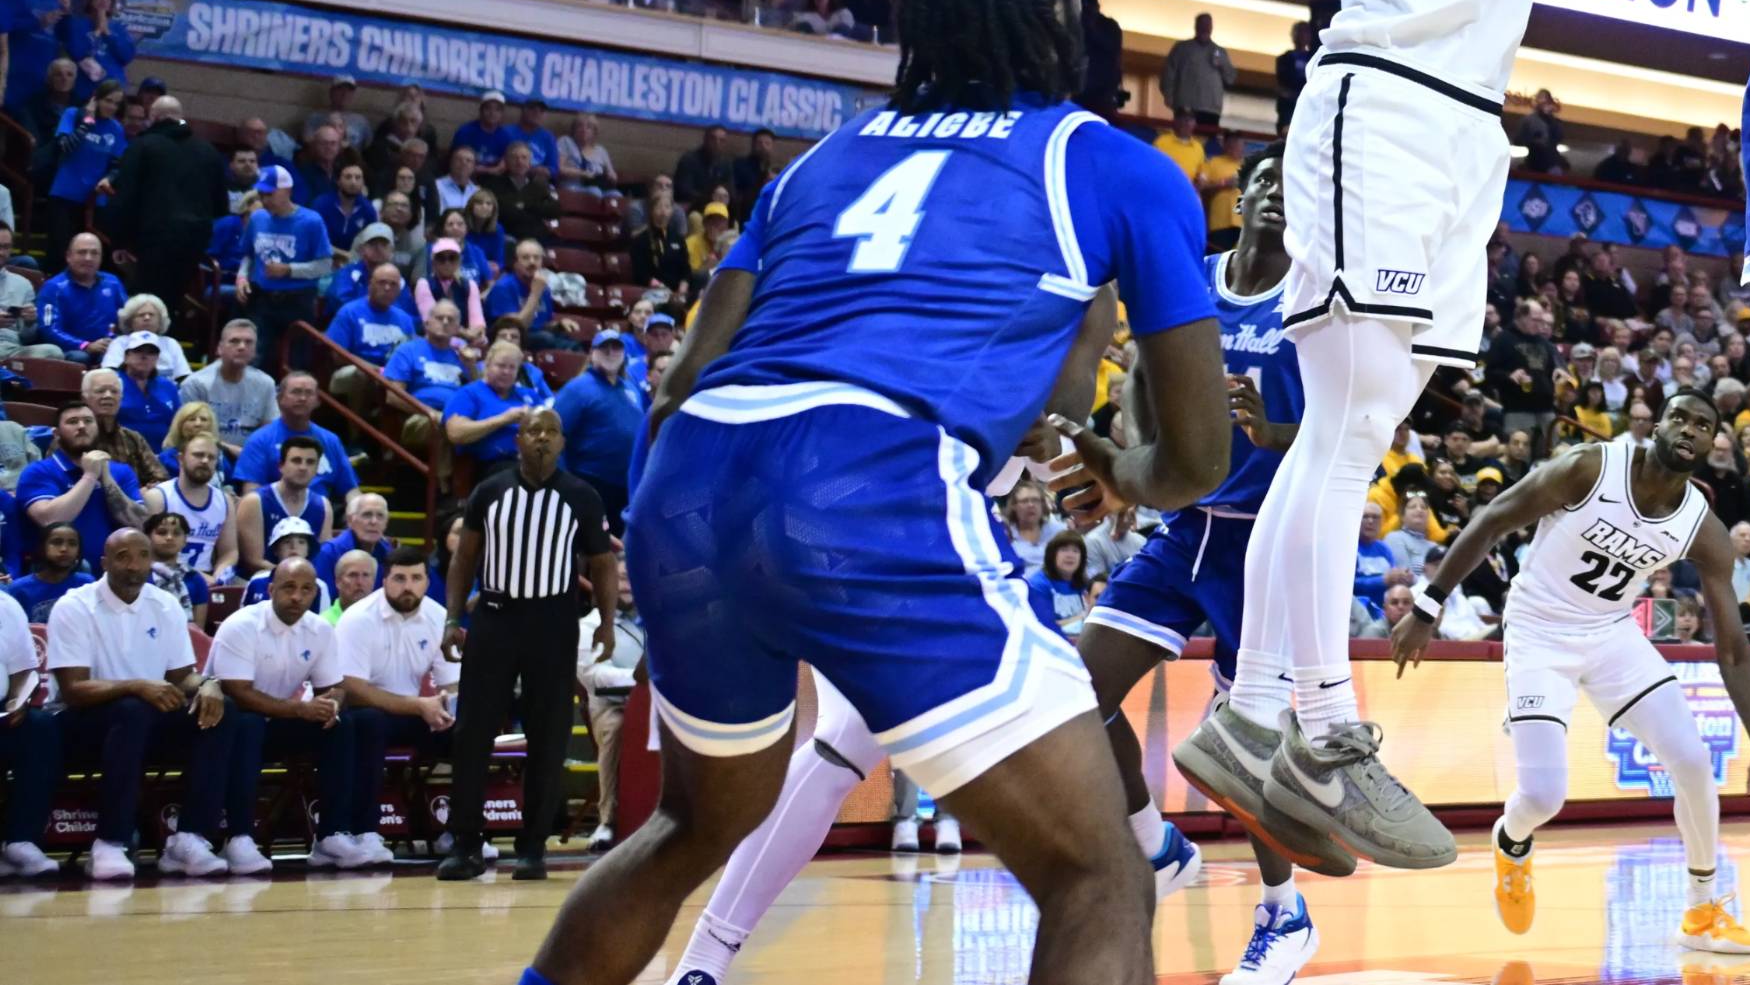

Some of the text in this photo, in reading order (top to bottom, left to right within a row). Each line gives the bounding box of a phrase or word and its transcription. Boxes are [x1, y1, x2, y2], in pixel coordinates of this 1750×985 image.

[187, 2, 843, 134] SHRINERS CHILDREN'S CHARLESTON CLASSIC
[832, 149, 954, 273] 4
[1376, 269, 1425, 295] VCU
[1233, 323, 1285, 355] Hall
[1580, 518, 1667, 570] RAMS
[1569, 550, 1636, 602] 22
[52, 809, 98, 821] Shrine
[55, 822, 97, 833] Childr
